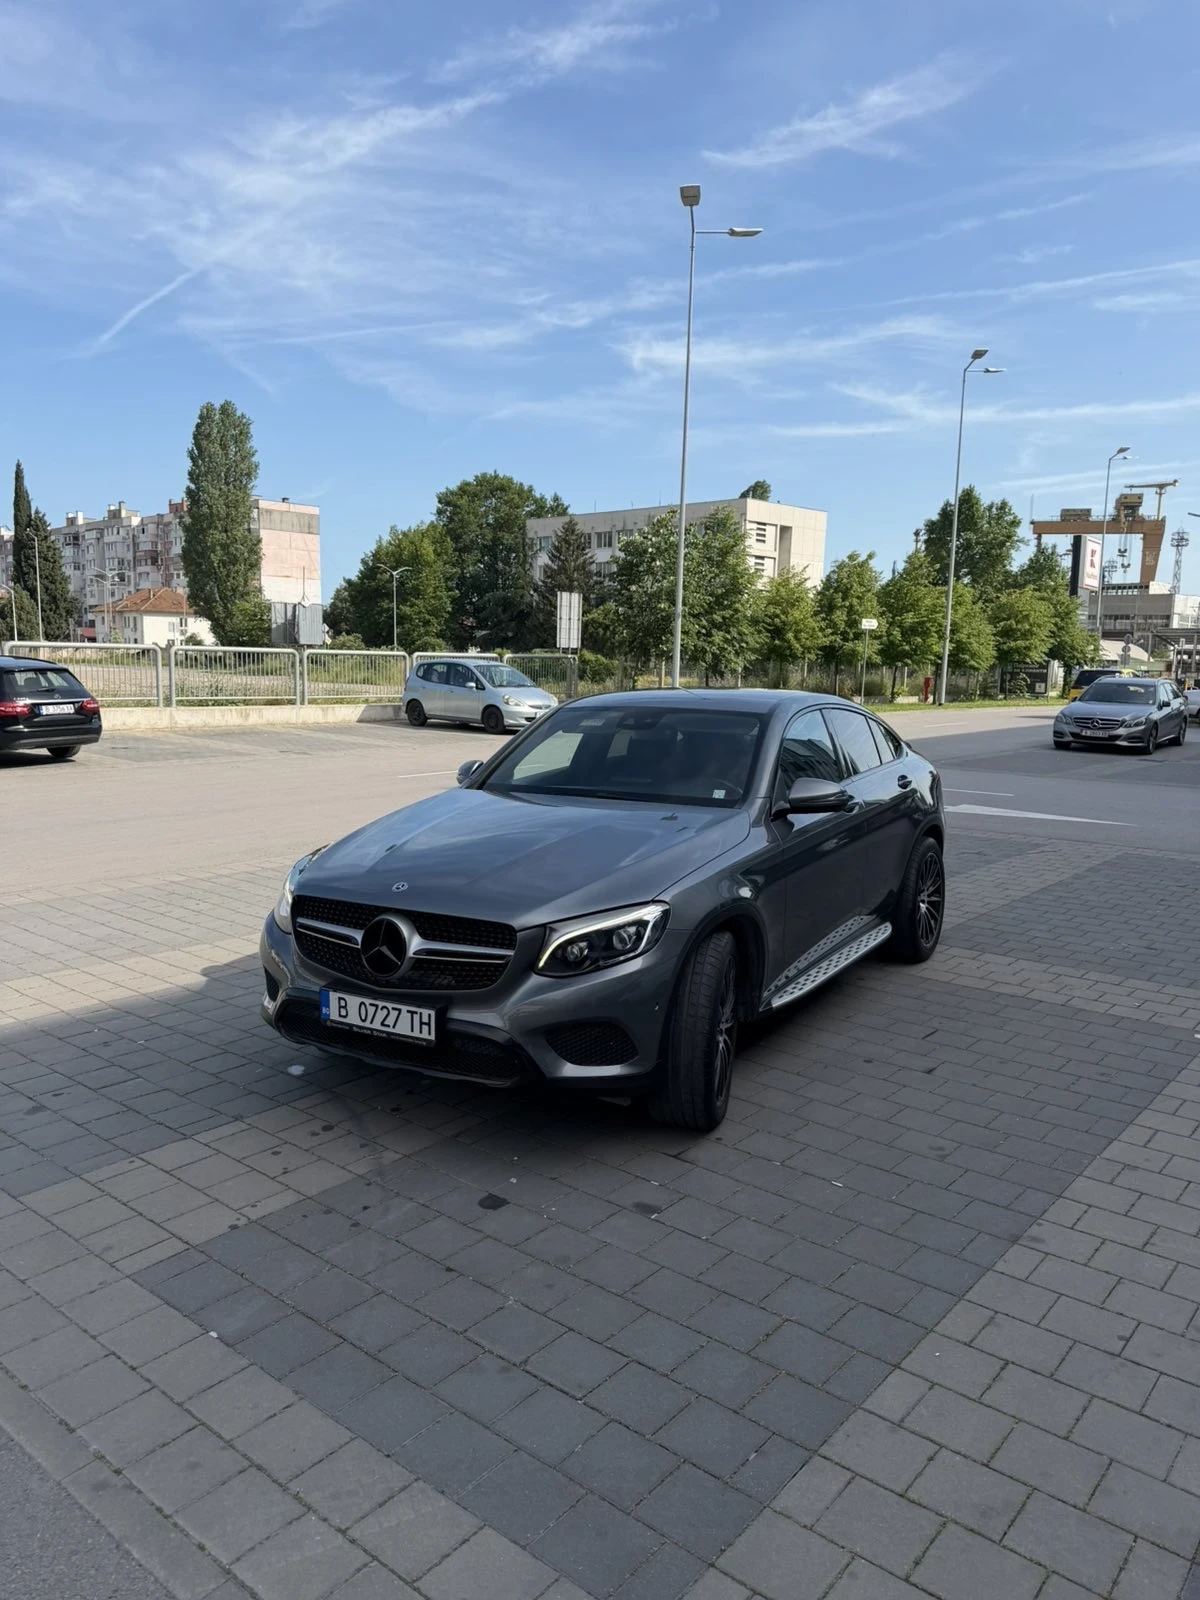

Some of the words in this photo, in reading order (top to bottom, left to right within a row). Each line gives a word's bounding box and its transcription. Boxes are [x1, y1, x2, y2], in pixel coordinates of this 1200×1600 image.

[338, 996, 349, 1019] B
[358, 1001, 402, 1029] 0727
[406, 1009, 432, 1036] TH
